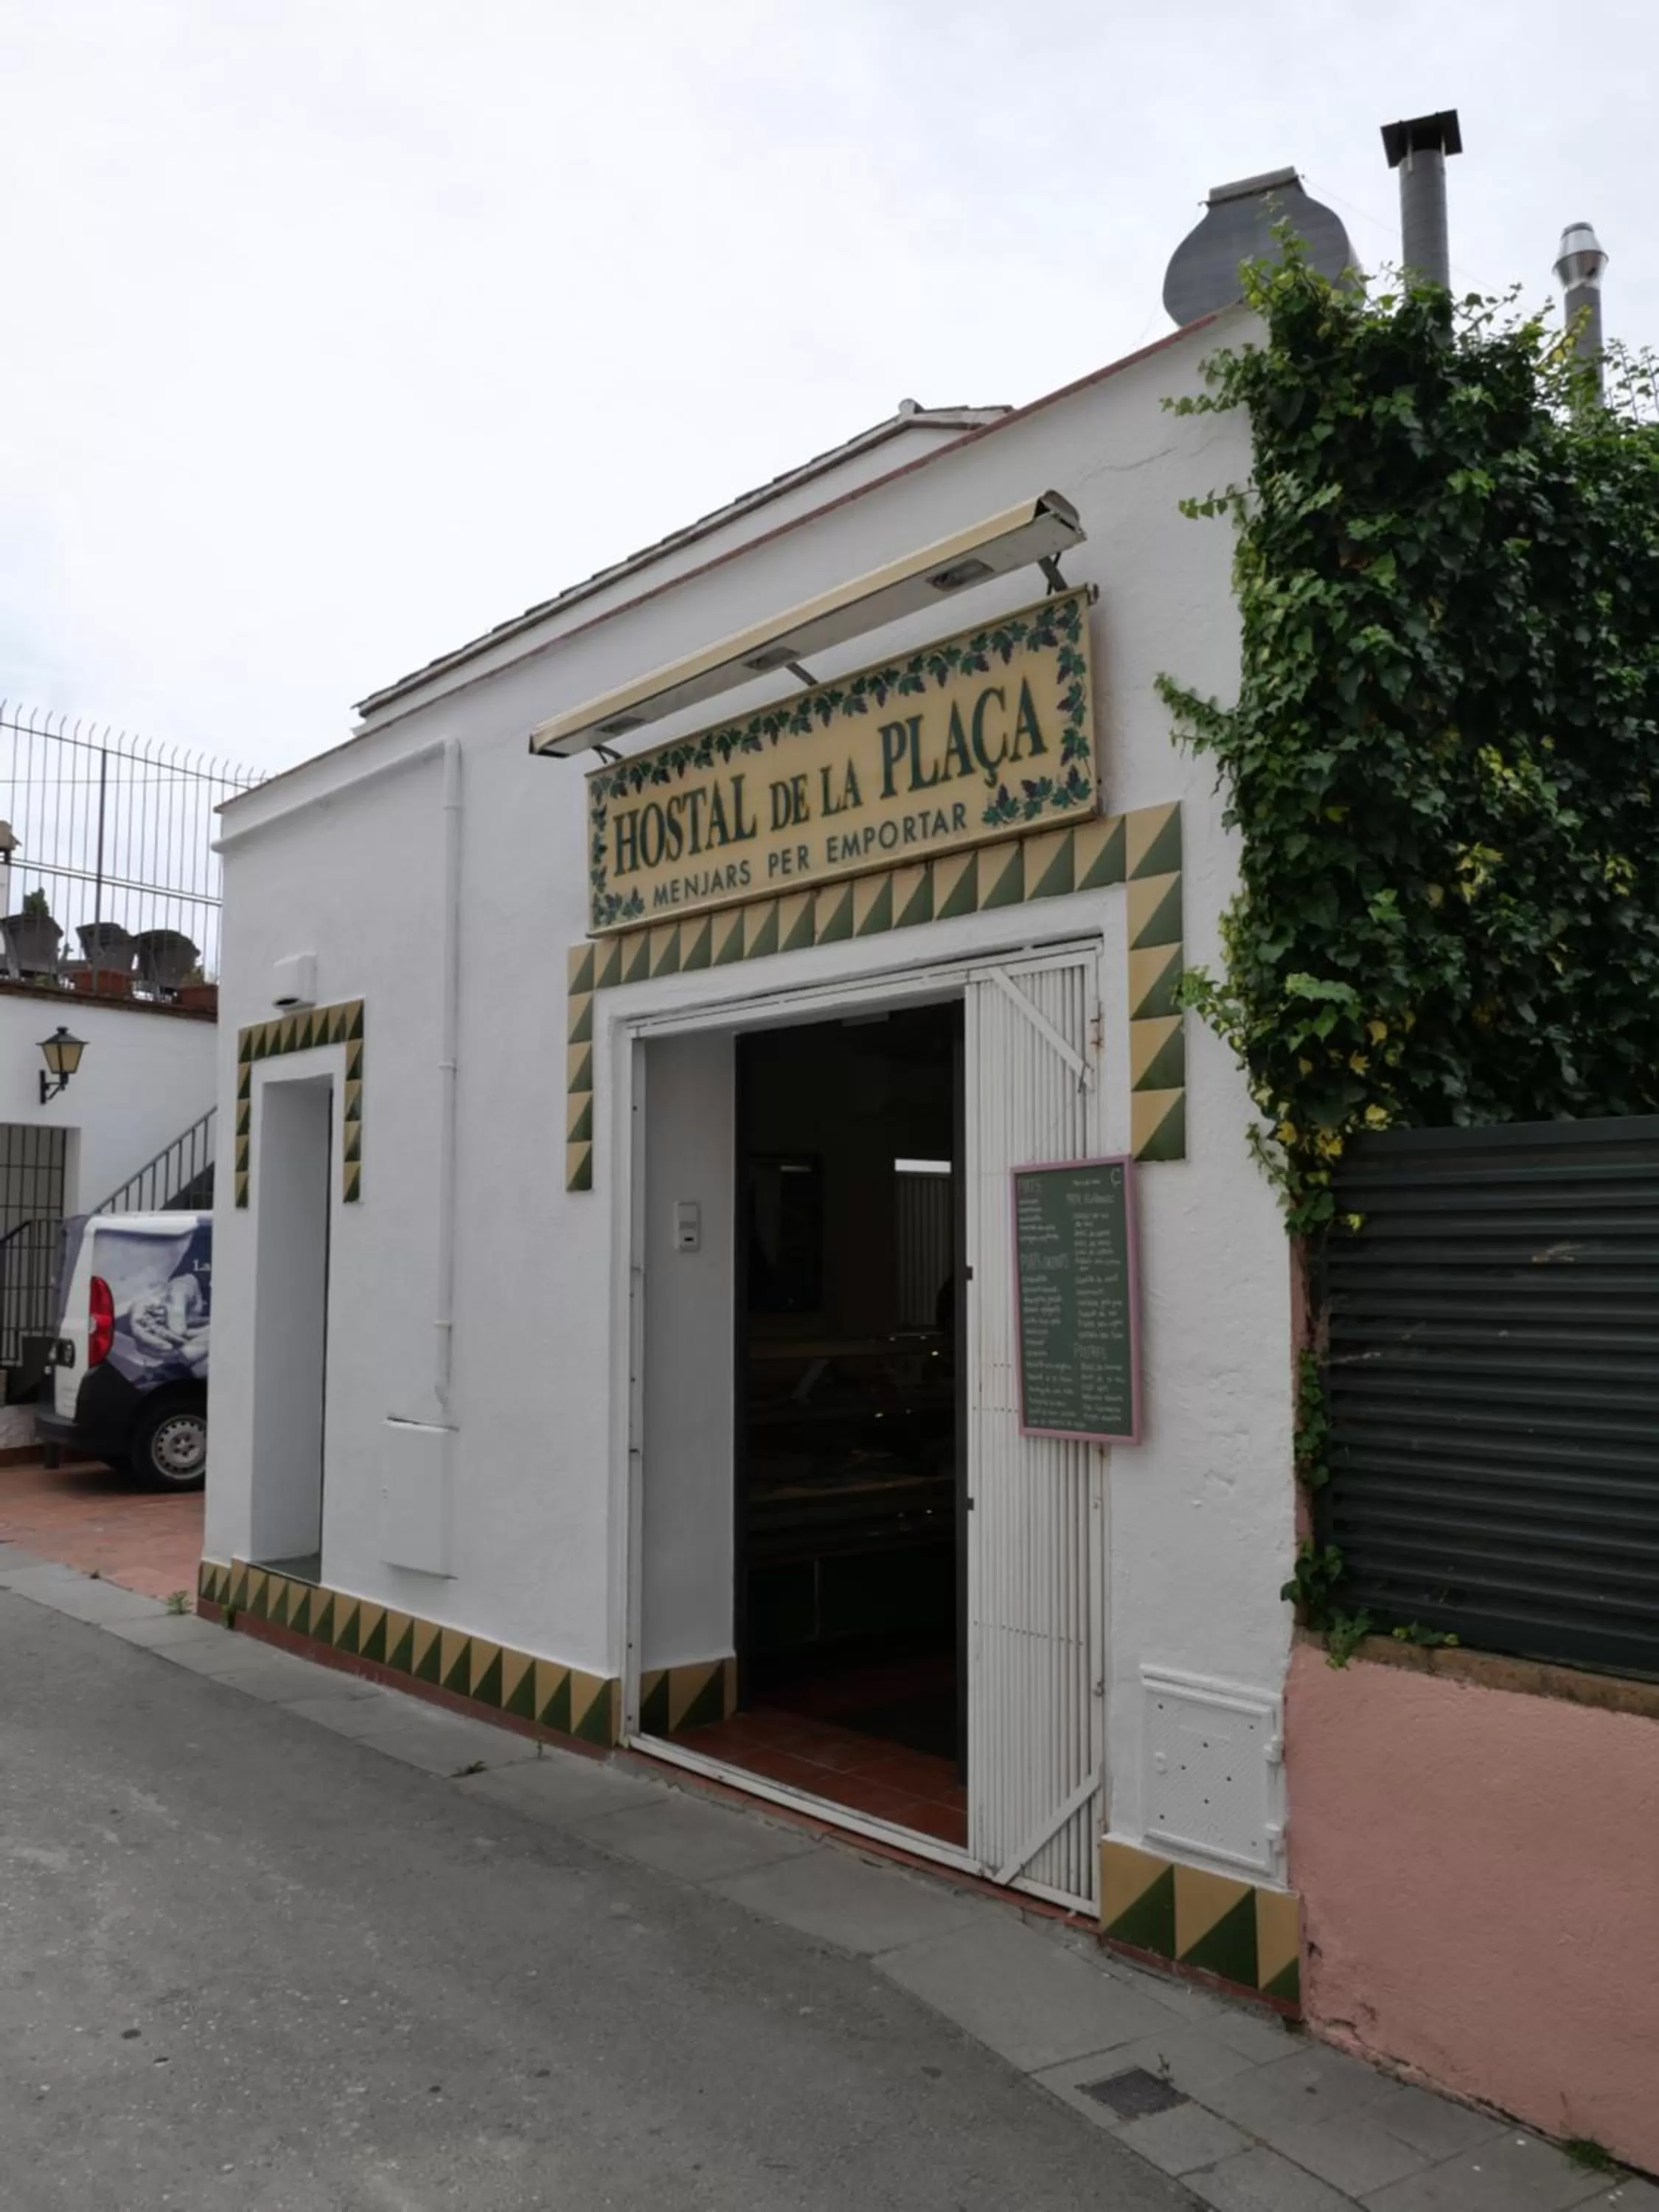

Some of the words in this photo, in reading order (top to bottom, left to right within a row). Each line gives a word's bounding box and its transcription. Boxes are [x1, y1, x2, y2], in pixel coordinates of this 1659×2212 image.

[613, 771, 758, 877] HOSTAL
[770, 773, 810, 831] DE
[820, 757, 863, 817] LA
[878, 676, 1048, 799] PLAÇA
[653, 859, 752, 908] MENJARS
[768, 844, 810, 878] PER
[827, 801, 967, 864] EMPORTAR
